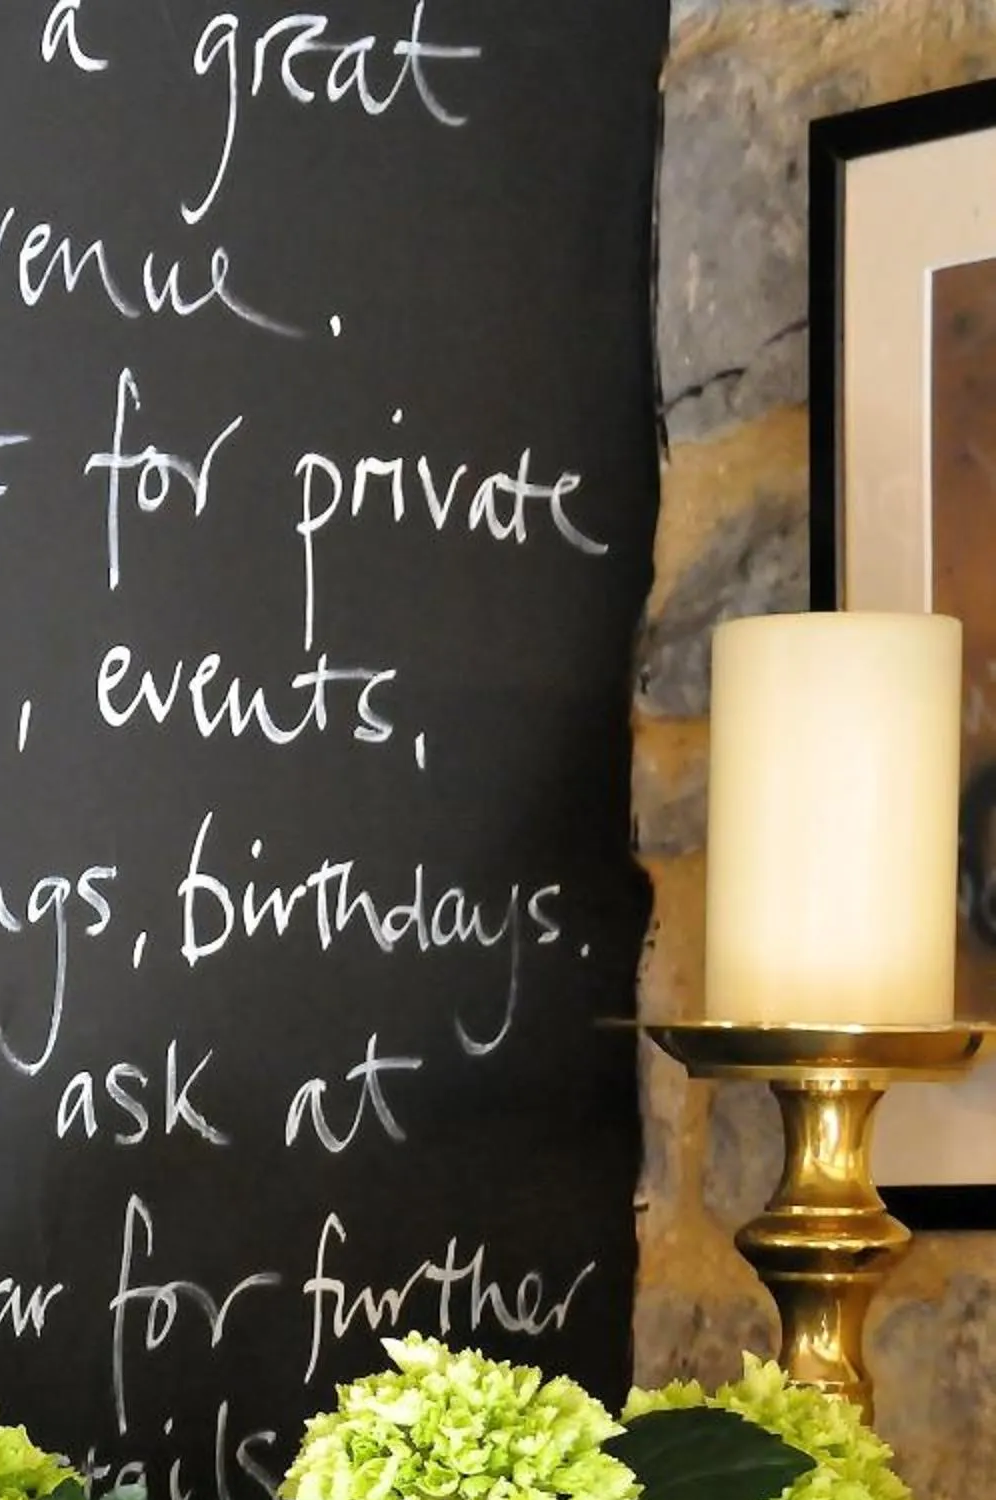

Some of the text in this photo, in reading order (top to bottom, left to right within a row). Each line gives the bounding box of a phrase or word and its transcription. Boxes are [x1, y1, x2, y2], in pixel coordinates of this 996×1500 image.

[41, 0, 109, 72] a
[180, 0, 482, 225] great
[83, 366, 244, 592] for
[293, 408, 609, 653] private
[97, 643, 427, 770] events,
[177, 810, 591, 1055] birthdays.
[56, 1038, 230, 1146] ask
[285, 1032, 424, 1153] at
[108, 1192, 282, 1435] for
[300, 1211, 598, 1384] further
